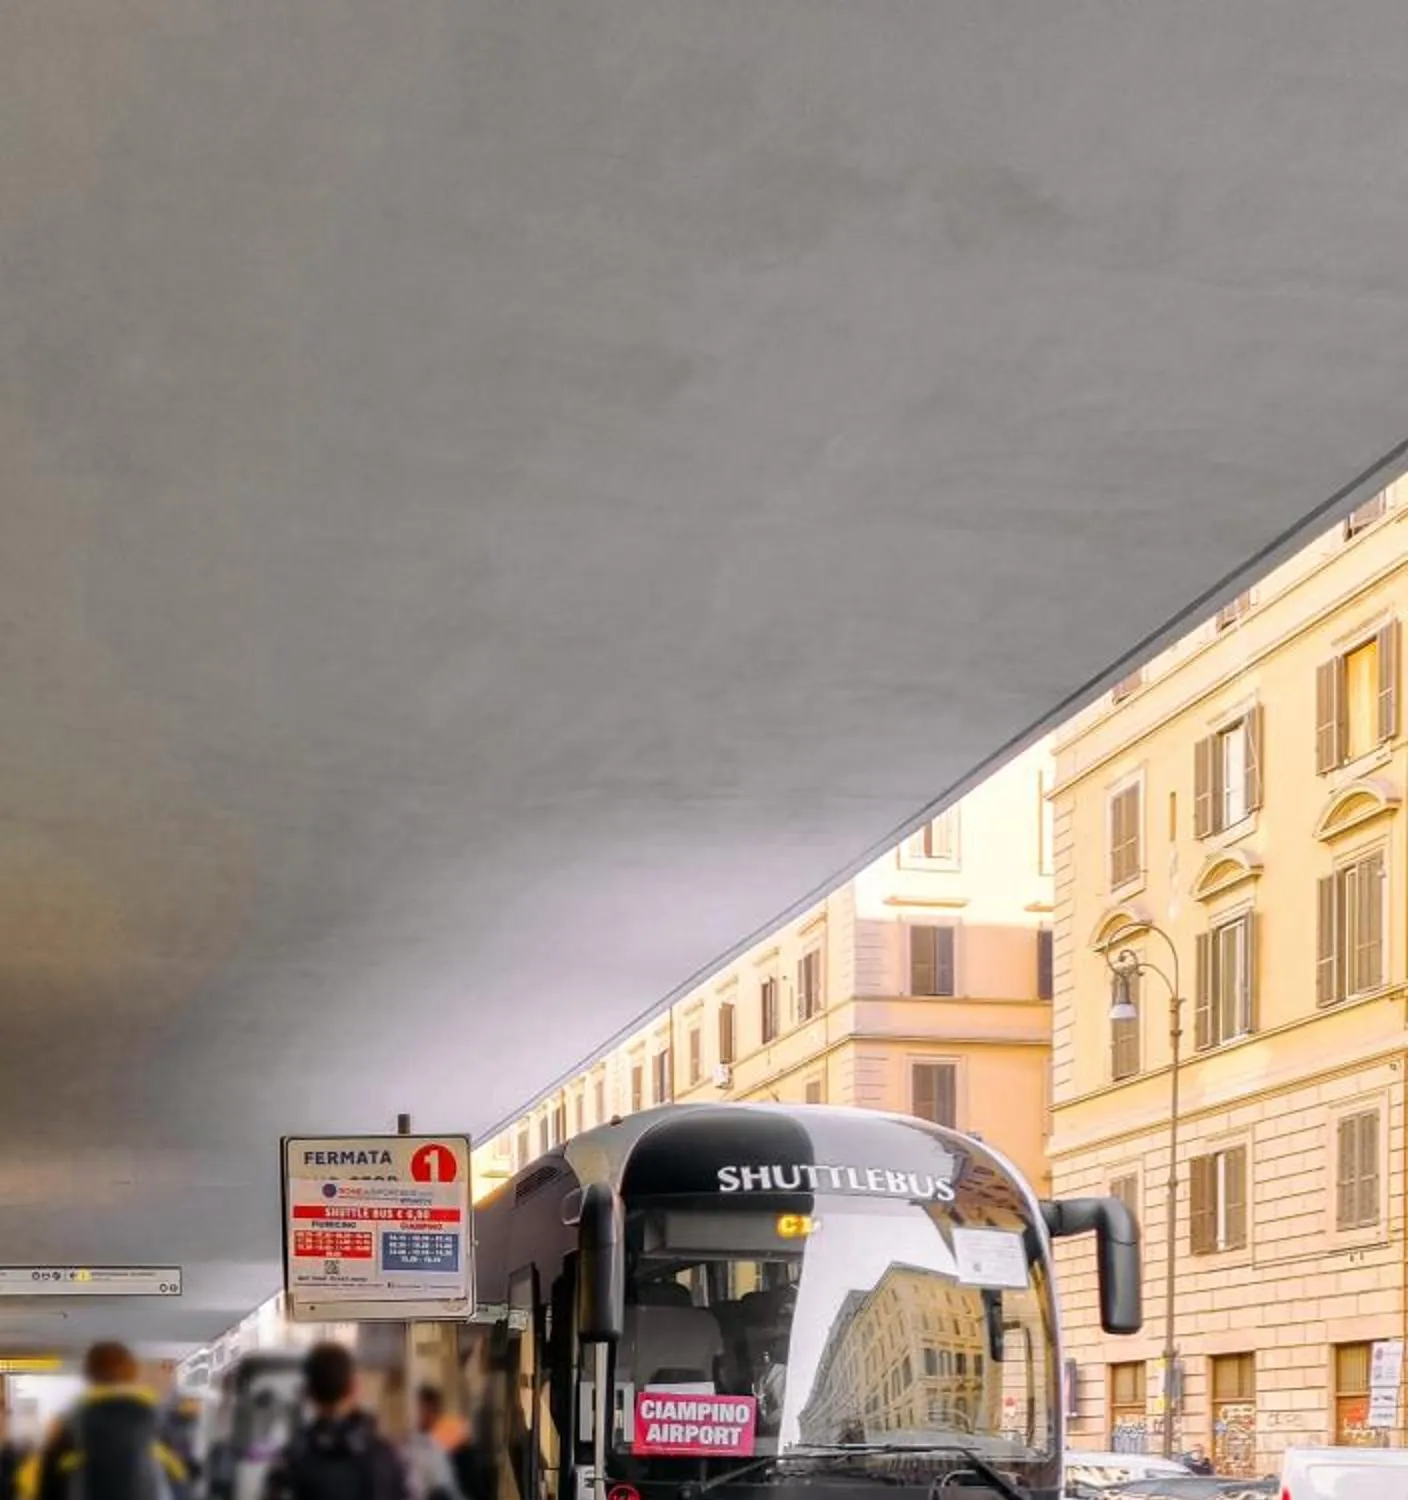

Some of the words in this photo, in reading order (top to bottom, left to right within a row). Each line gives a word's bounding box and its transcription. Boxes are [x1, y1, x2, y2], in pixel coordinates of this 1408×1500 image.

[303, 1151, 392, 1165] FERMATA
[424, 1150, 440, 1182] 1
[717, 1164, 955, 1200] SHUTTLEBUS
[640, 1400, 750, 1424] CIAMPINO
[646, 1423, 742, 1446] AIRPORT
